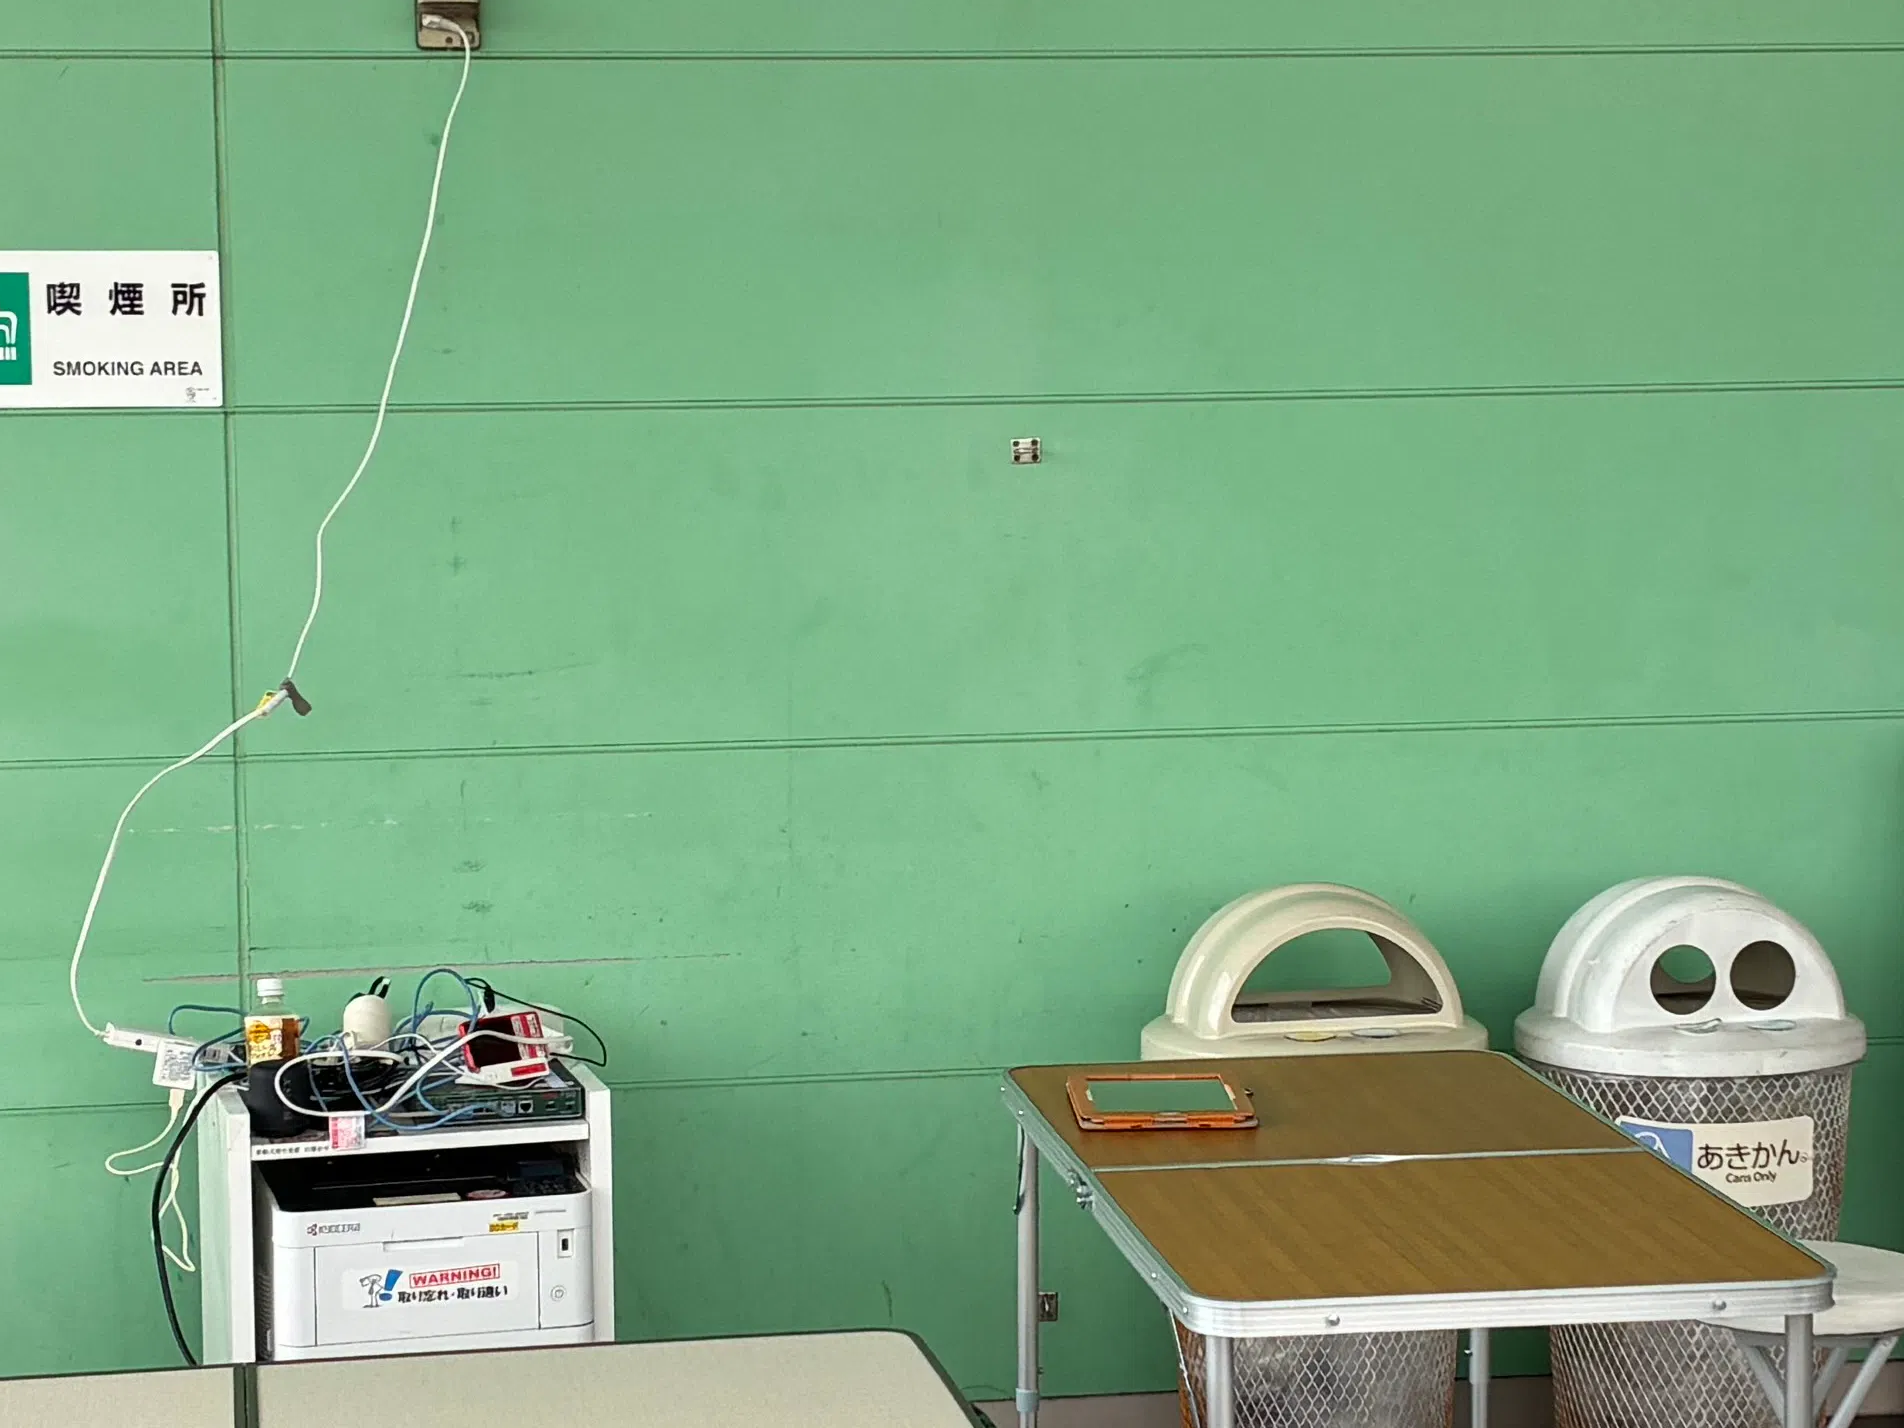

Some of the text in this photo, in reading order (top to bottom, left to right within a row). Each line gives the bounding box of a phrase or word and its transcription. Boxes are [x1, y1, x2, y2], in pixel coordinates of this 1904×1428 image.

[46, 282, 205, 317] 喫煙所
[53, 360, 203, 377] SMOKING AREA
[1697, 1139, 1799, 1170] あきかん
[1753, 1171, 1777, 1182] Only
[412, 1266, 497, 1286] WARNING!
